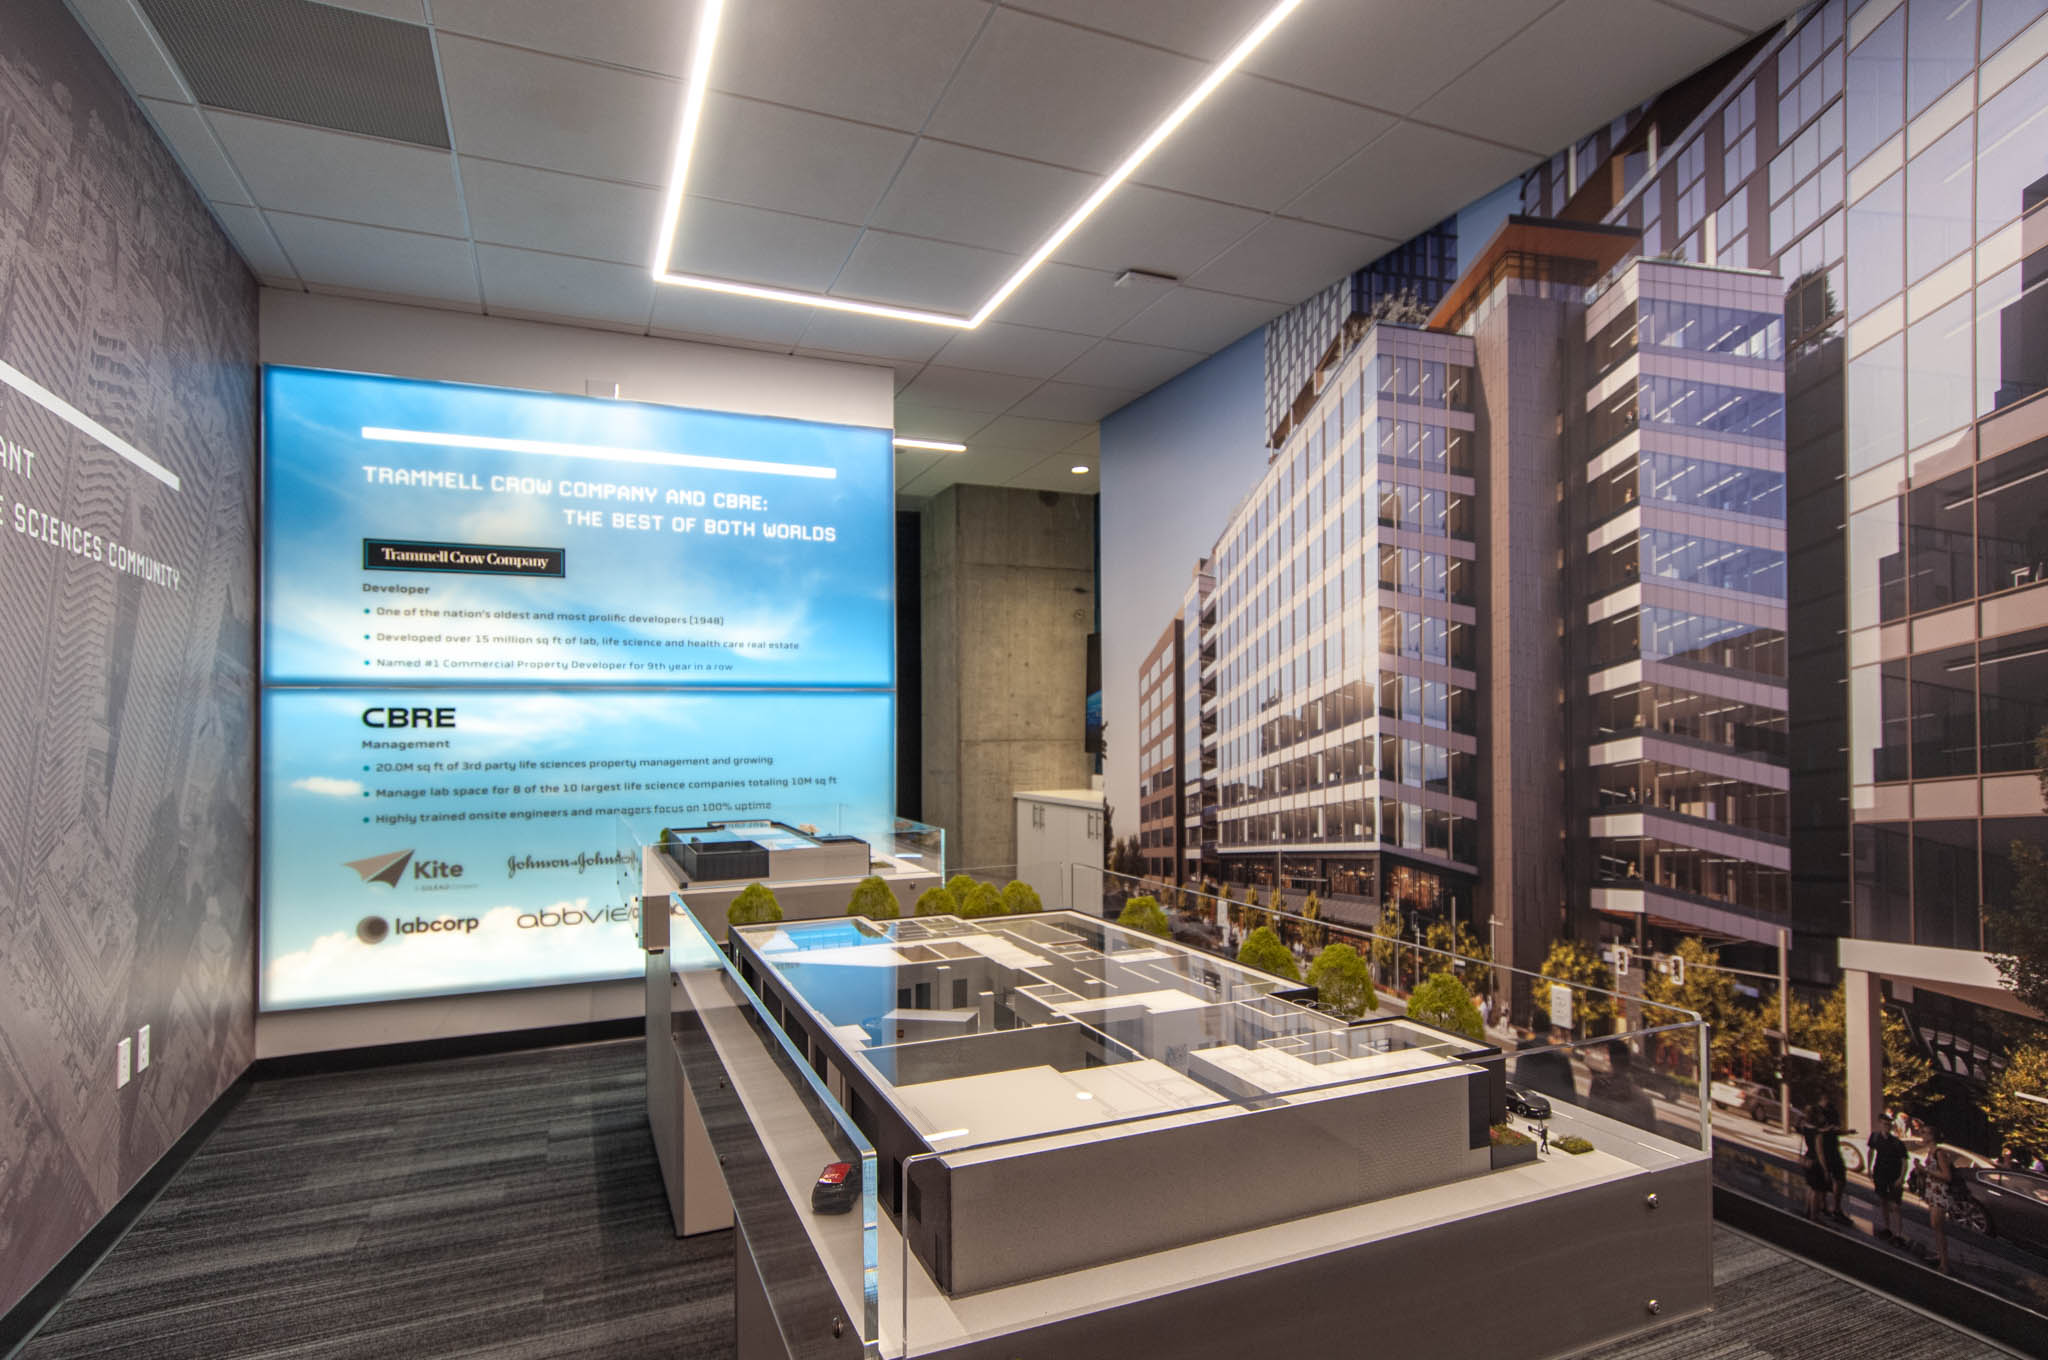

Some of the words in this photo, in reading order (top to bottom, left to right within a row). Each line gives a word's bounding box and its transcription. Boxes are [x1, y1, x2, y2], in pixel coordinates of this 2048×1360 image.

[362, 466, 483, 491] TRAMMELL
[491, 475, 553, 495] CROW
[559, 480, 658, 503] COMPANY
[666, 489, 706, 507] AND
[713, 492, 768, 511] CBRE:
[563, 508, 603, 527] THE
[612, 512, 664, 531] BEST
[671, 516, 697, 533] OF
[704, 518, 756, 537] BOTH
[762, 522, 837, 542] WORLDS
[14, 502, 102, 562] SCIENCES
[108, 542, 180, 591] COMMUNITY
[381, 547, 448, 564] Trammell
[450, 551, 485, 565] Crow
[486, 552, 549, 569] Company
[362, 583, 430, 596] Developer
[376, 607, 400, 616] One
[419, 608, 440, 618] the
[443, 609, 491, 619] nation's
[493, 610, 530, 620] oldest
[533, 611, 554, 621] and
[557, 612, 586, 622] most
[588, 613, 626, 624] prolific
[628, 614, 687, 625] developers
[376, 633, 441, 643] Developed
[445, 635, 471, 643] over
[493, 635, 533, 645] million
[580, 636, 599, 647] lab,
[602, 637, 619, 646] life
[622, 638, 662, 647] science
[664, 638, 684, 648] and
[687, 639, 721, 648] health
[723, 641, 744, 649] care
[747, 640, 766, 649] real
[768, 641, 800, 650] estate
[376, 659, 421, 668] Named
[443, 659, 514, 669] Commercial
[517, 660, 568, 671] Property
[571, 661, 626, 671] Developer
[648, 662, 666, 670] 9th
[668, 663, 691, 672] year
[362, 707, 456, 728] CBRE
[362, 740, 450, 750] Management
[462, 761, 481, 770] 3rd
[484, 761, 516, 772] party
[519, 760, 537, 769] life
[540, 760, 586, 769] sciences
[589, 758, 636, 769] property
[639, 757, 709, 768] management
[712, 756, 731, 766] and
[733, 756, 774, 766] growing
[376, 788, 427, 799] Manage
[430, 786, 450, 797] lab
[453, 787, 489, 798] space
[492, 785, 509, 795] for
[539, 784, 560, 794] the
[581, 782, 621, 793] largest
[624, 780, 641, 790] life
[644, 780, 685, 790] science
[688, 779, 746, 790] companies
[748, 778, 788, 789] totaling
[791, 776, 812, 786] 10M
[376, 813, 417, 825] Highly
[420, 811, 466, 822] trained
[468, 810, 507, 820] onsite
[509, 808, 568, 820] engineers
[571, 807, 592, 817] and
[595, 806, 652, 817] managers
[654, 803, 684, 814] focus
[702, 803, 732, 812] 100%
[734, 801, 772, 812] uptime
[414, 860, 464, 880] Kite
[395, 916, 480, 934] labcorp
[516, 904, 628, 929] abbvie
